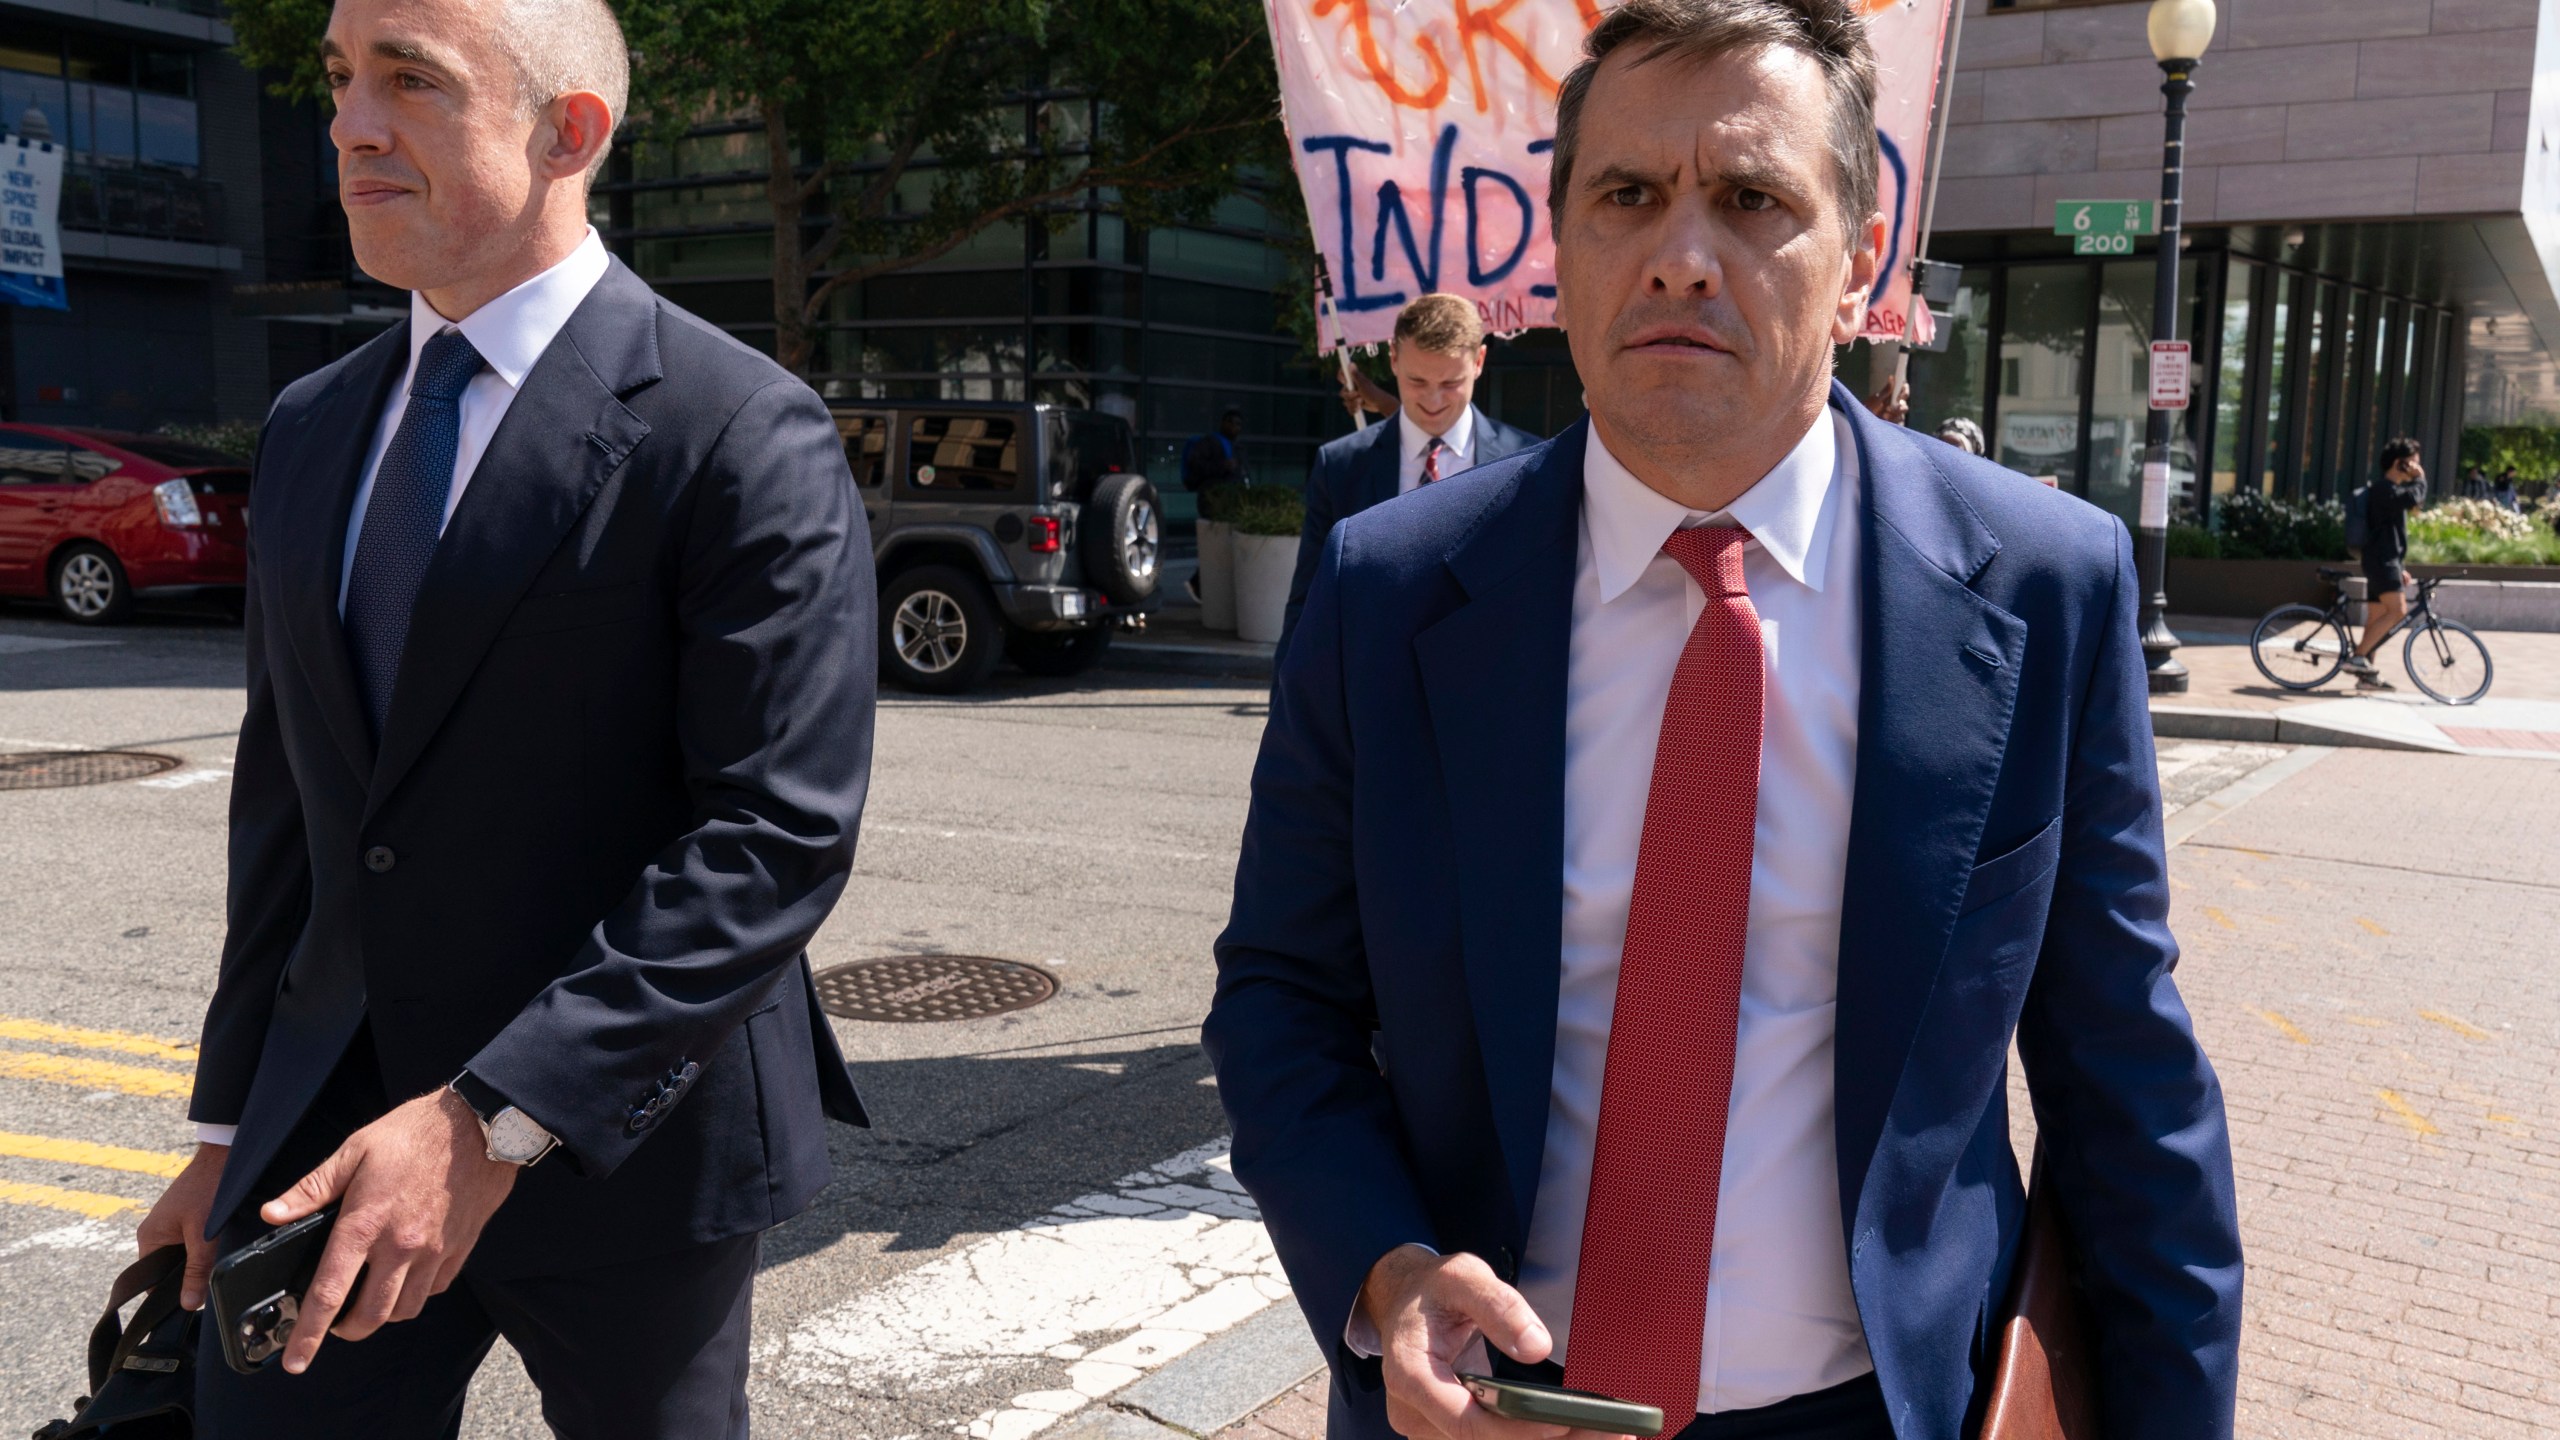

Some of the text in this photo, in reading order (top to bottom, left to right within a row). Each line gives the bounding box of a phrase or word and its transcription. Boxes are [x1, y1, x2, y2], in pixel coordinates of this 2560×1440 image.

[2, 189, 37, 209] SPACE
[9, 210, 33, 227] FOR
[2073, 204, 2139, 231] 6 St
[2124, 218, 2140, 231] NW
[0, 229, 45, 249] GLOBAL
[2080, 235, 2128, 252] 200
[3, 249, 44, 267] IMPACT
